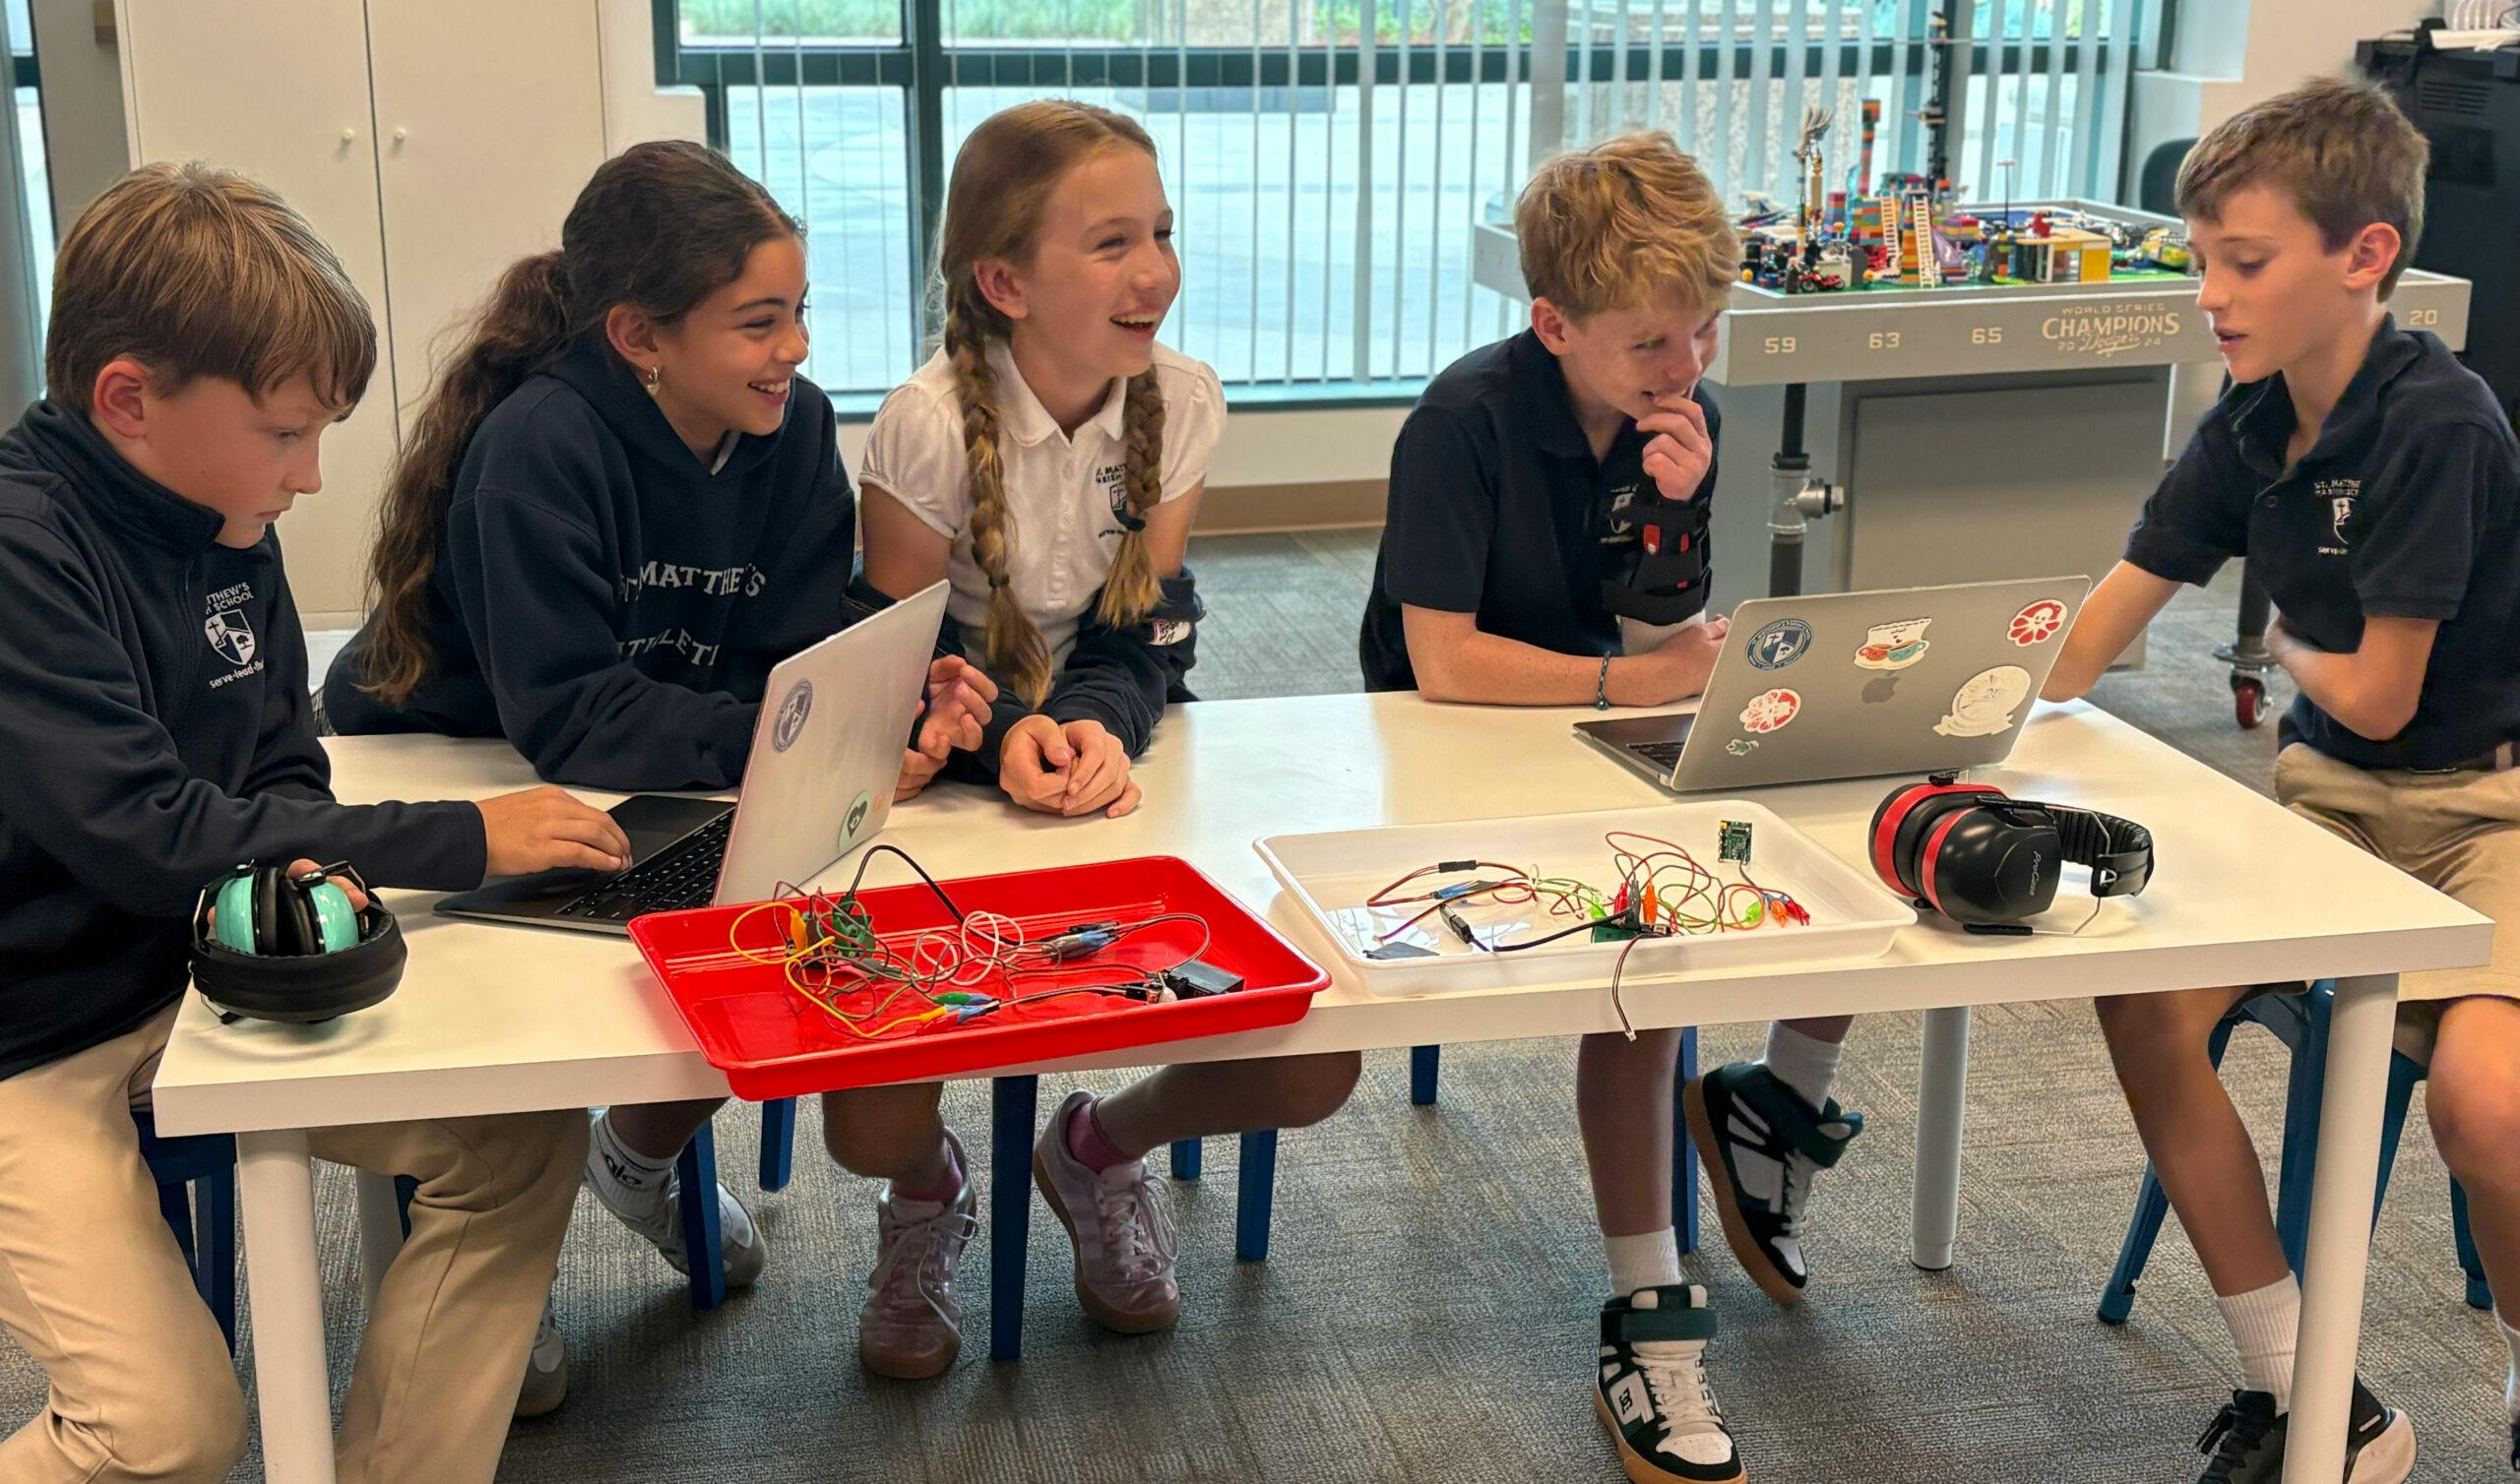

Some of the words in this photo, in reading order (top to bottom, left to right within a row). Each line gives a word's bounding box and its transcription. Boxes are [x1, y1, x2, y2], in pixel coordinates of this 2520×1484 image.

[2062, 306, 2111, 315] WORLD
[2409, 309, 2437, 326] 20
[2042, 312, 2181, 340] CHAMPIONS
[1868, 332, 1901, 349] 63
[1972, 327, 2003, 344] 65
[1764, 337, 1796, 354] 59
[206, 582, 250, 605] TTHEW'S
[214, 591, 255, 611] SCHOOL
